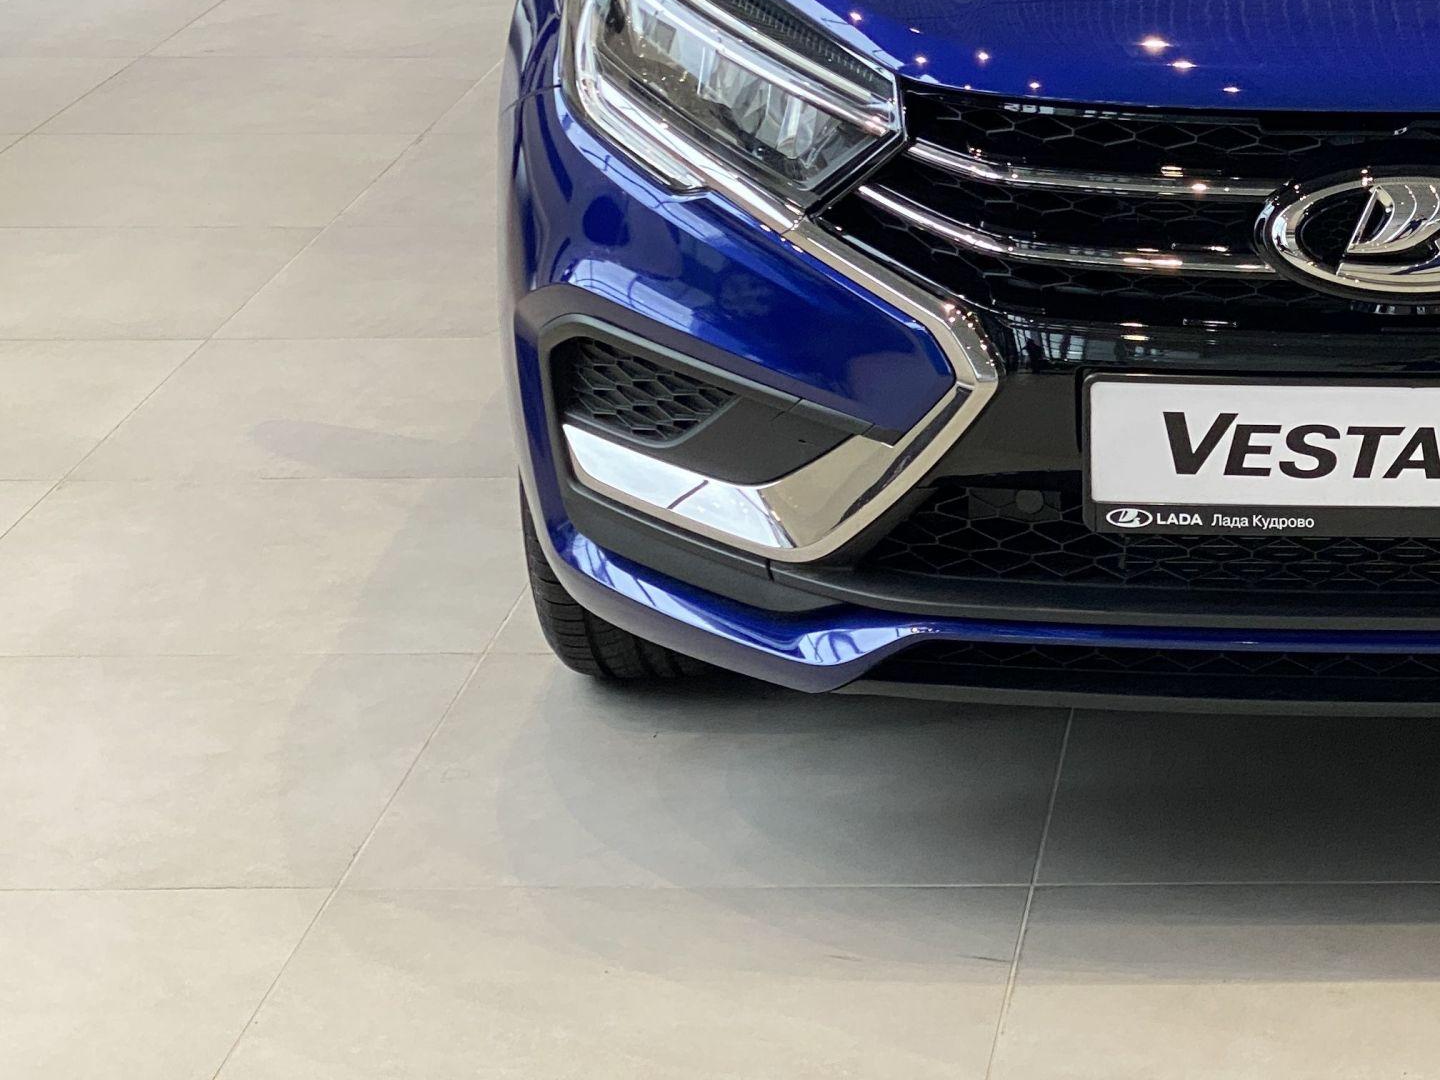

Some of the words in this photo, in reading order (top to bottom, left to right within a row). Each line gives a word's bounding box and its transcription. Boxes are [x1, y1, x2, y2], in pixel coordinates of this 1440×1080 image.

[1156, 512, 1204, 526] LADA
[1211, 513, 1249, 528] Лада
[1252, 514, 1315, 530] Кудрово
